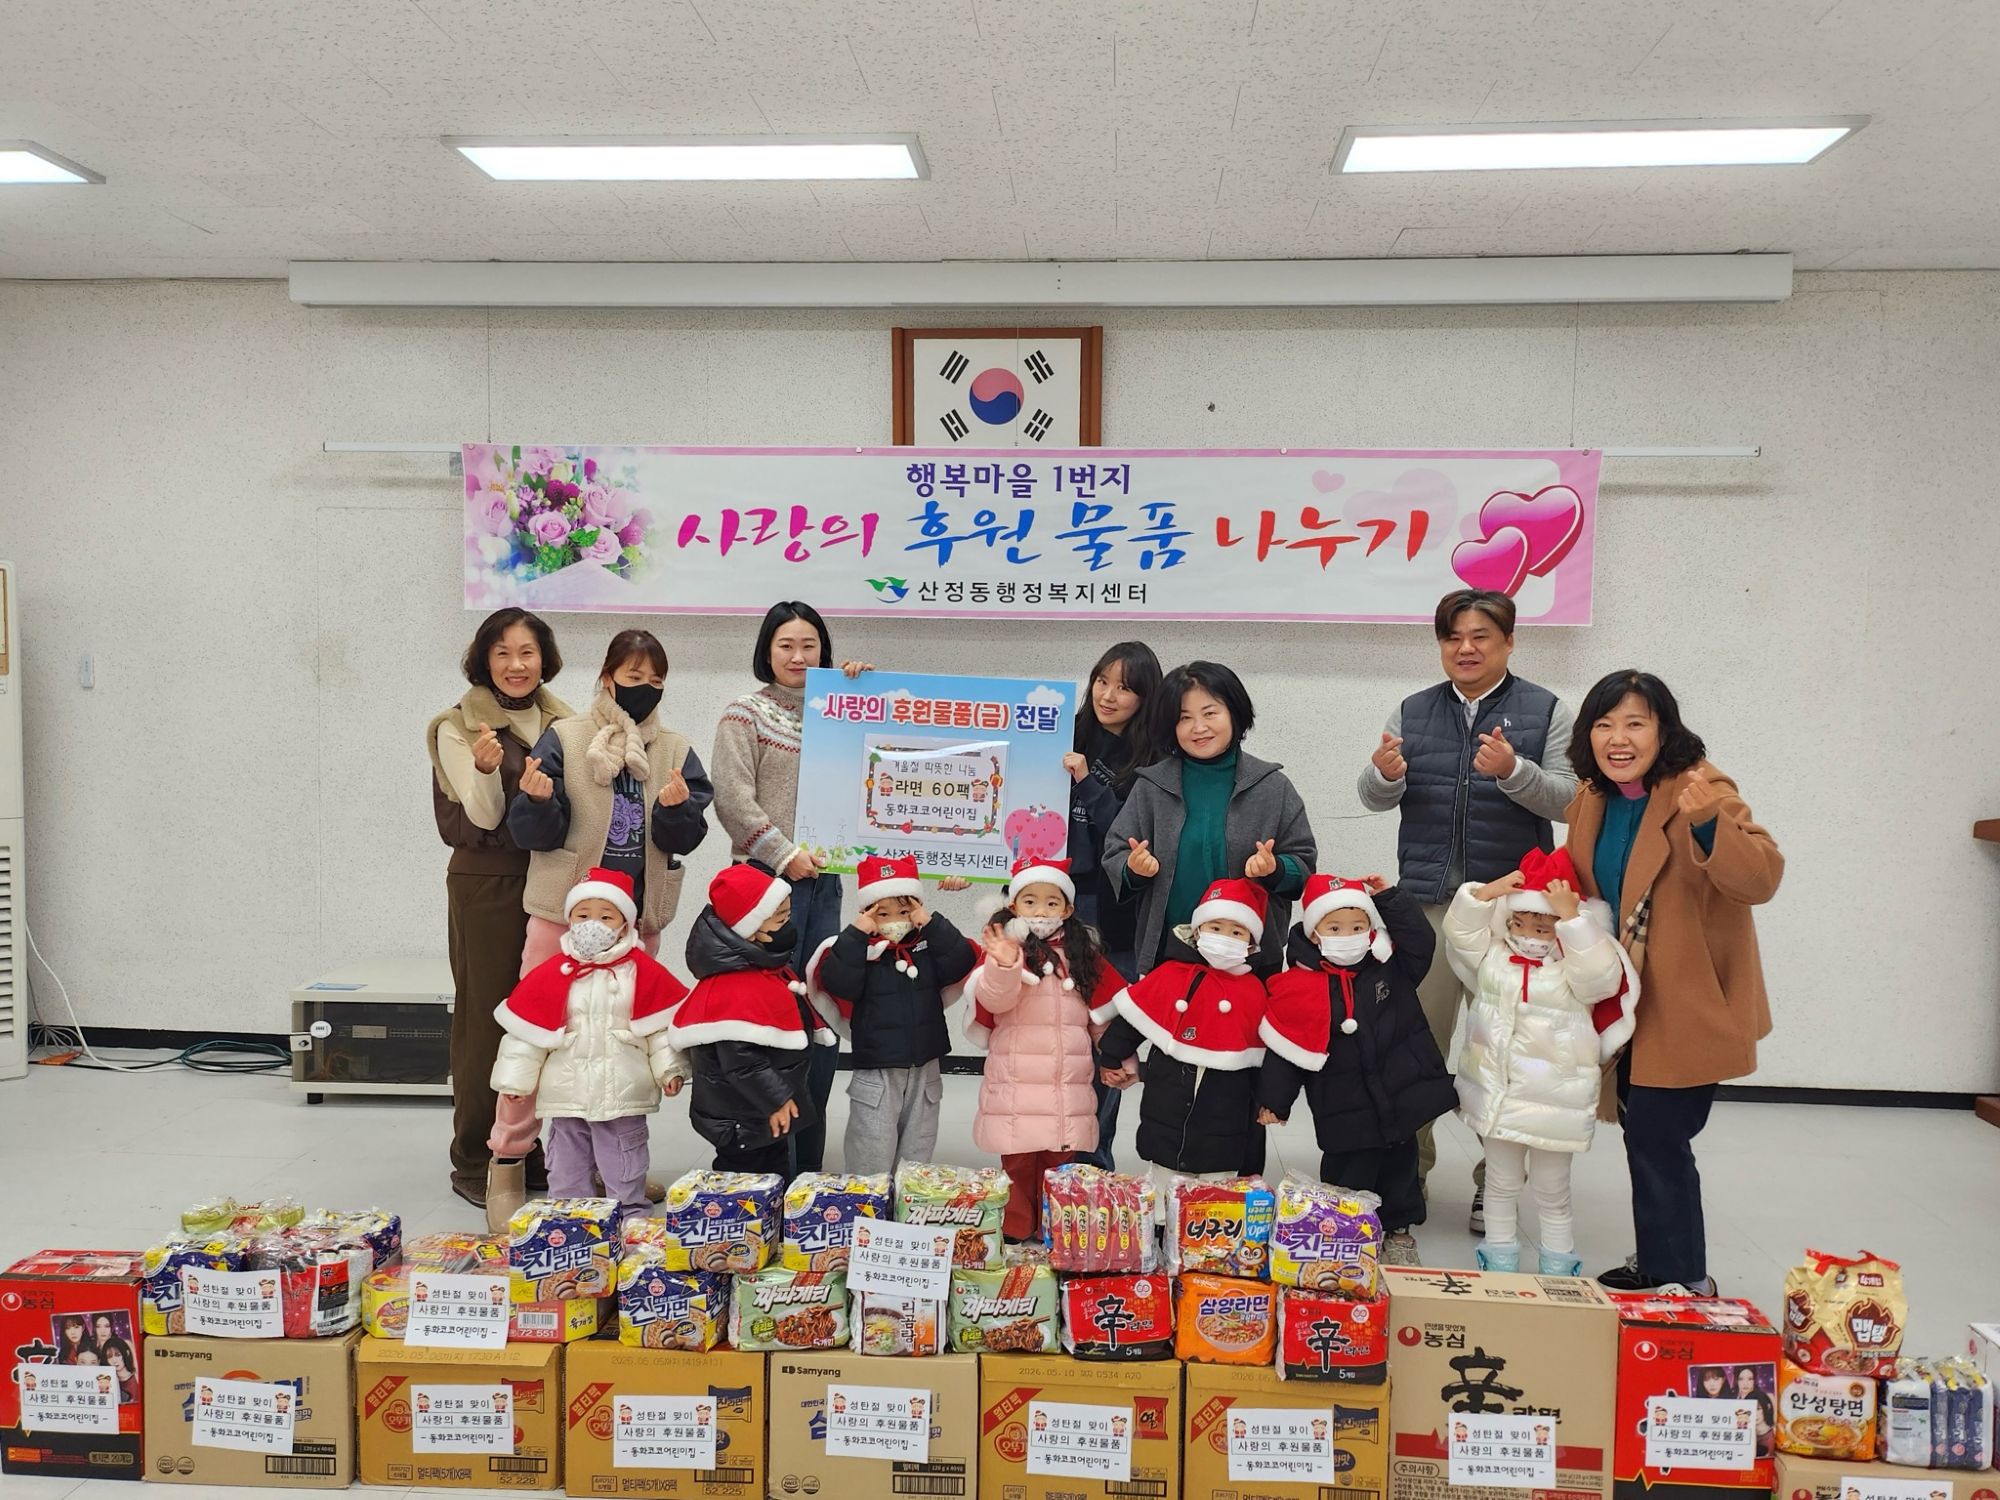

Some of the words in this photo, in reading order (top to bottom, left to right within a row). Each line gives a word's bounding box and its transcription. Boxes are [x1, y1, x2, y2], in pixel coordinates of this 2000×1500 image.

[906, 463, 1037, 499] 행복마을
[1054, 463, 1131, 497] 1번지
[677, 505, 880, 563] 사랑의
[1215, 506, 1430, 570] 나누기
[917, 579, 1148, 604] 산정동행정복지센터
[823, 694, 886, 721] 사랑의
[891, 698, 1010, 729] 후원물품(금)
[1015, 703, 1060, 731] 전달
[925, 762, 953, 775] 따뜻한
[959, 764, 976, 777] 나눔
[895, 780, 922, 797] 라면
[932, 782, 970, 800] 60팩
[885, 803, 977, 821] 동화코코어린이집
[905, 1204, 984, 1227] 짜파게티
[678, 1217, 746, 1247] 진라면
[1187, 1218, 1244, 1241] 너구리
[798, 1223, 853, 1254] 진라
[874, 1236, 903, 1248] 성탄절
[911, 1240, 930, 1251] 맞이
[1288, 1233, 1362, 1262] 진라면
[523, 1247, 592, 1282] 진라면
[860, 1250, 891, 1264] 사랑의
[898, 1255, 941, 1269] 후원물품
[203, 1283, 229, 1295] 성탄절
[236, 1287, 256, 1296] 맞이
[432, 1290, 461, 1299] 성탄절
[468, 1291, 487, 1301] 맞이
[193, 1298, 220, 1309] 사랑의
[227, 1301, 271, 1311] 후원물품
[753, 1285, 831, 1313] 짜파게티
[1200, 1295, 1269, 1315] 삼양라면
[419, 1305, 450, 1316] 사랑의
[457, 1306, 499, 1318] 후원물품
[629, 1296, 690, 1327] 진라면
[960, 1296, 1038, 1323] 짜파게티
[1094, 1294, 1136, 1351] 辛
[1307, 1316, 1351, 1373] 辛
[1424, 1331, 1465, 1348] 농심
[169, 1350, 212, 1360] Samyang
[797, 1366, 841, 1377] Samyang
[40, 1378, 68, 1389] 성탄절
[75, 1380, 94, 1391] 맞이
[29, 1393, 60, 1405] 사랑의
[66, 1395, 107, 1406] 후원물품
[217, 1394, 246, 1406] 성탄절
[253, 1398, 273, 1408] 맞이
[434, 1400, 464, 1409] 성탄절
[470, 1400, 490, 1409] 맞이
[850, 1401, 880, 1412] 성탄절
[887, 1403, 906, 1413] 맞이
[1790, 1393, 1863, 1417] 안성탕면
[203, 1409, 235, 1421] 사랑의
[241, 1412, 284, 1426] 후원물품
[422, 1416, 454, 1425] 사랑의
[460, 1416, 503, 1426] 후원물품
[636, 1411, 666, 1421] 성탄절
[673, 1412, 693, 1421] 맞이
[1672, 1414, 1703, 1424] 성탄절
[1711, 1415, 1732, 1425] 맞이
[836, 1418, 869, 1427] 사랑의
[875, 1419, 919, 1432] 후원물품
[1051, 1418, 1081, 1429] 성탄절
[1088, 1420, 1108, 1431] 맞이
[1251, 1425, 1281, 1435] 성탄절
[1288, 1426, 1309, 1436] 맞이
[624, 1428, 656, 1437] 사랑의
[663, 1428, 706, 1439] 후원물품
[1472, 1429, 1503, 1440] 성탄절
[1510, 1431, 1531, 1441] 맞이
[1657, 1429, 1691, 1439] 사랑의
[1699, 1430, 1744, 1442] 후원물품
[1037, 1434, 1070, 1446] 사랑의
[1077, 1437, 1121, 1450] 후원물품
[1238, 1441, 1271, 1452] 사랑의
[1278, 1442, 1322, 1453] 후원물품
[1459, 1446, 1492, 1456] 사랑의
[1499, 1447, 1545, 1459] 후원물품
[1399, 1464, 1434, 1475] 주의사항
